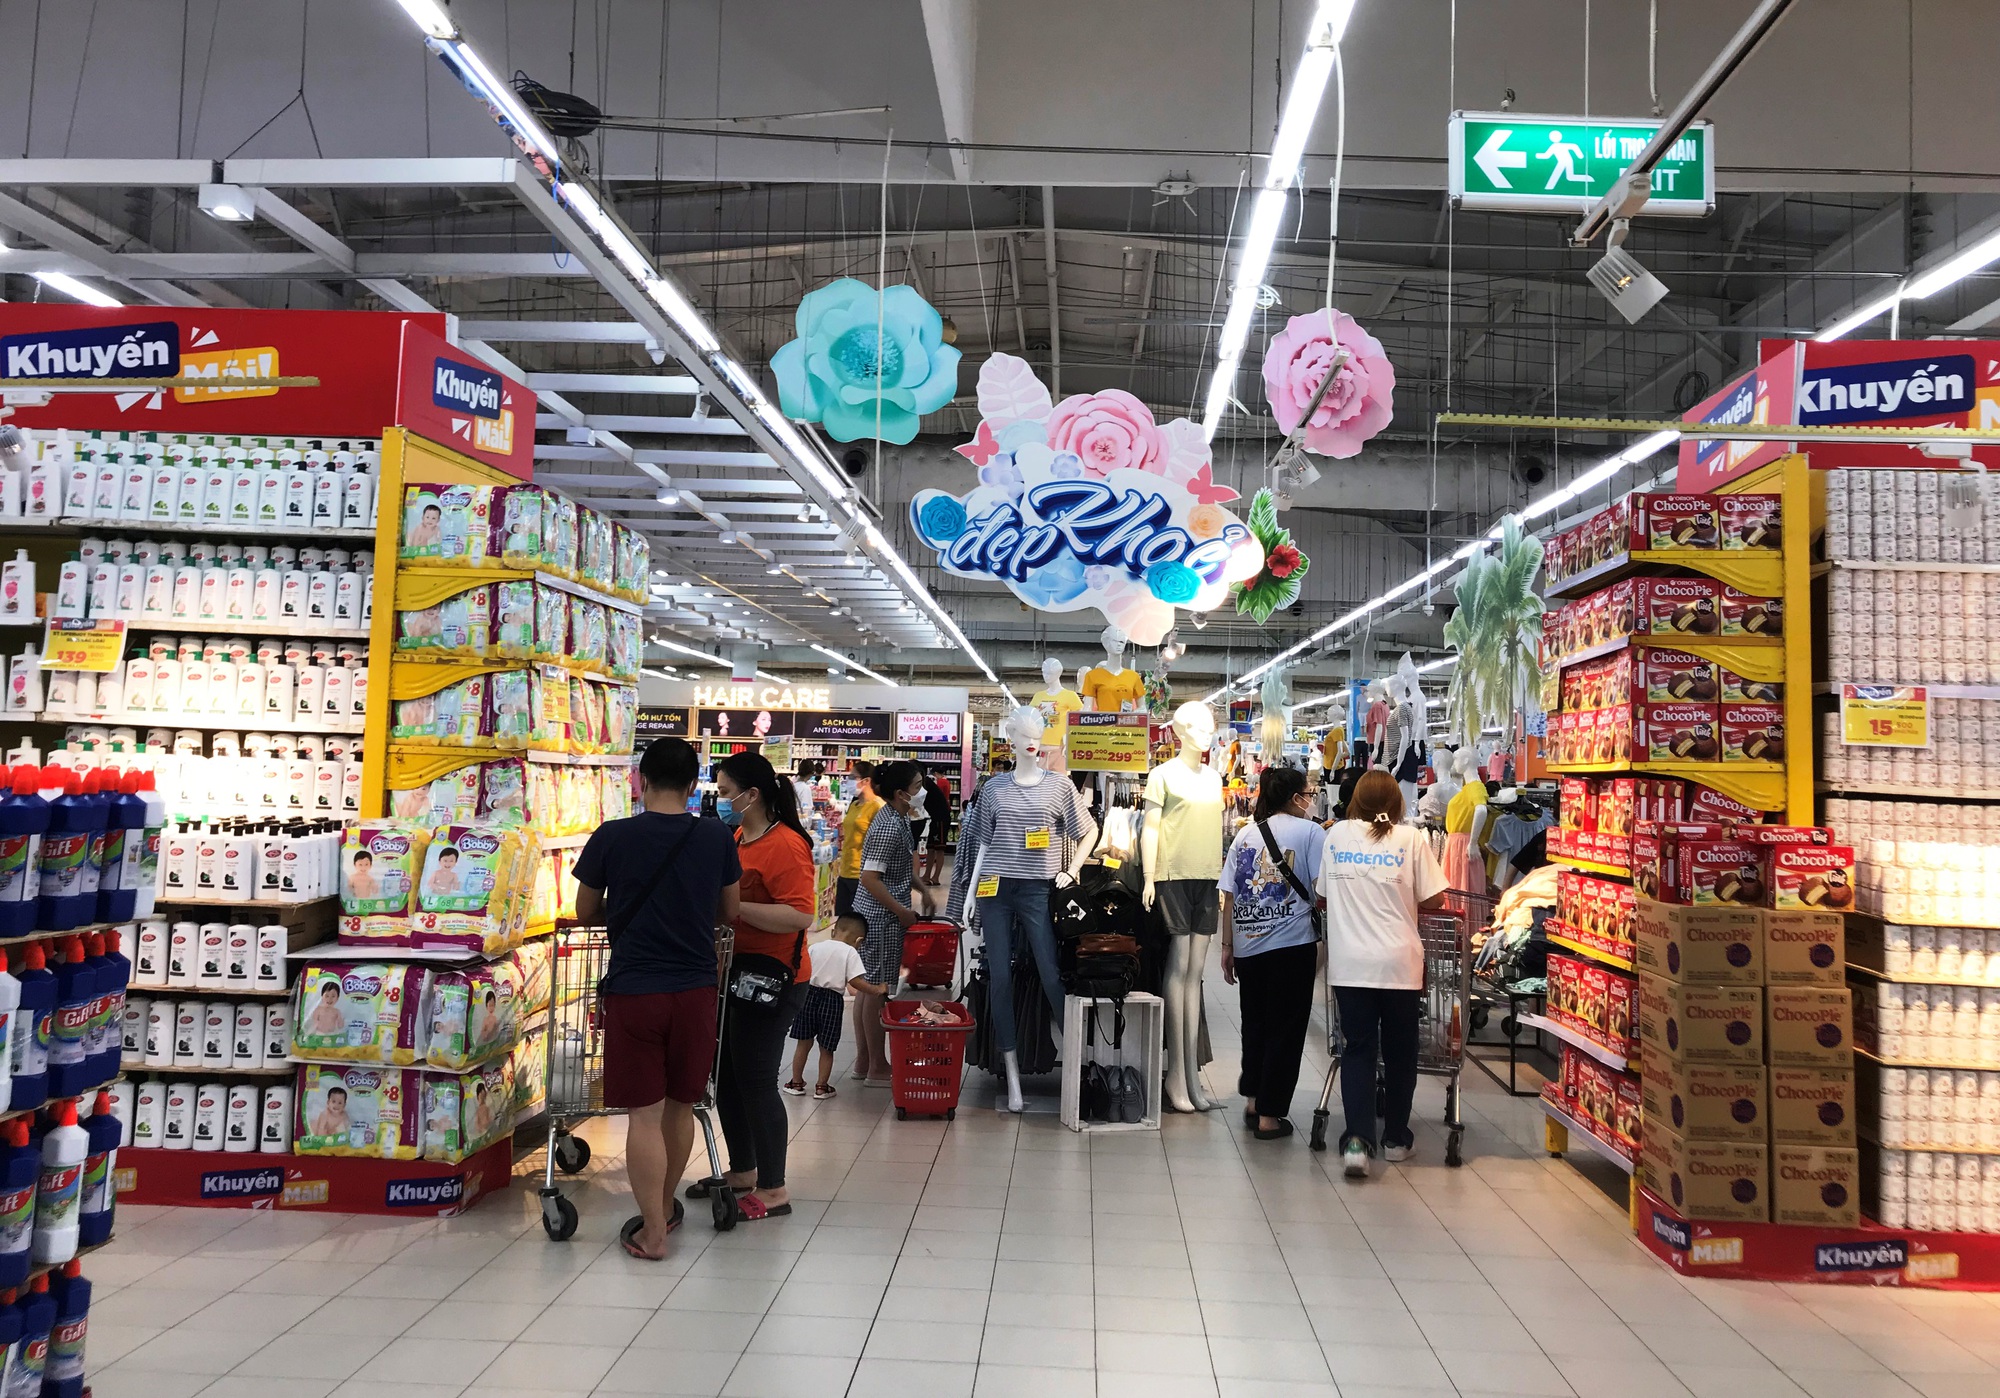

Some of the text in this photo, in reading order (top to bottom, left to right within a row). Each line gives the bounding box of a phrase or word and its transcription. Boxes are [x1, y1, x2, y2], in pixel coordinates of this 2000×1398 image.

[1595, 129, 1616, 159] LỐI
[8, 331, 169, 377] Khuyến
[436, 367, 498, 409] Khuyến
[1654, 500, 1711, 511] ChocoPie
[1723, 500, 1780, 512] ChocoPie
[951, 503, 1060, 583] đẹp
[1655, 584, 1712, 597] ChocoPie
[57, 651, 87, 663] 139
[694, 686, 830, 709] HAIR CARE
[1653, 710, 1711, 721] ChocoPie
[1726, 711, 1783, 723] ChocoPie
[832, 727, 872, 735] DANDRUFF
[1869, 719, 1893, 735] 15
[1071, 750, 1094, 760] 199
[1108, 752, 1132, 762] 299
[1760, 831, 1810, 843] ChocoPie
[373, 839, 409, 853] Bobby
[462, 837, 496, 852] Bobby
[1634, 844, 1657, 858] ChocoPie
[1697, 850, 1758, 863] ChocoPie
[1780, 852, 1847, 866] ChocoPie
[362, 902, 372, 910] 68
[440, 899, 451, 907] 68
[344, 916, 362, 931] +8
[420, 913, 437, 929] +8
[1687, 928, 1753, 942] ChocoPie
[1770, 928, 1836, 942] ChocoPie
[346, 979, 378, 993] Bobby
[384, 987, 401, 1003] +8
[1686, 1005, 1752, 1020] ChocoPie
[1773, 1007, 1842, 1022] ChocoPie
[349, 1073, 379, 1087] Bobby
[383, 1085, 400, 1101] +8
[1690, 1083, 1757, 1097] ChocoPie
[1775, 1085, 1844, 1100] ChocoPie
[1689, 1161, 1758, 1177] ChocoPie
[204, 1171, 280, 1193] Khuyến
[388, 1179, 462, 1202] Khuyến
[1818, 1243, 1904, 1268] Khuyến
